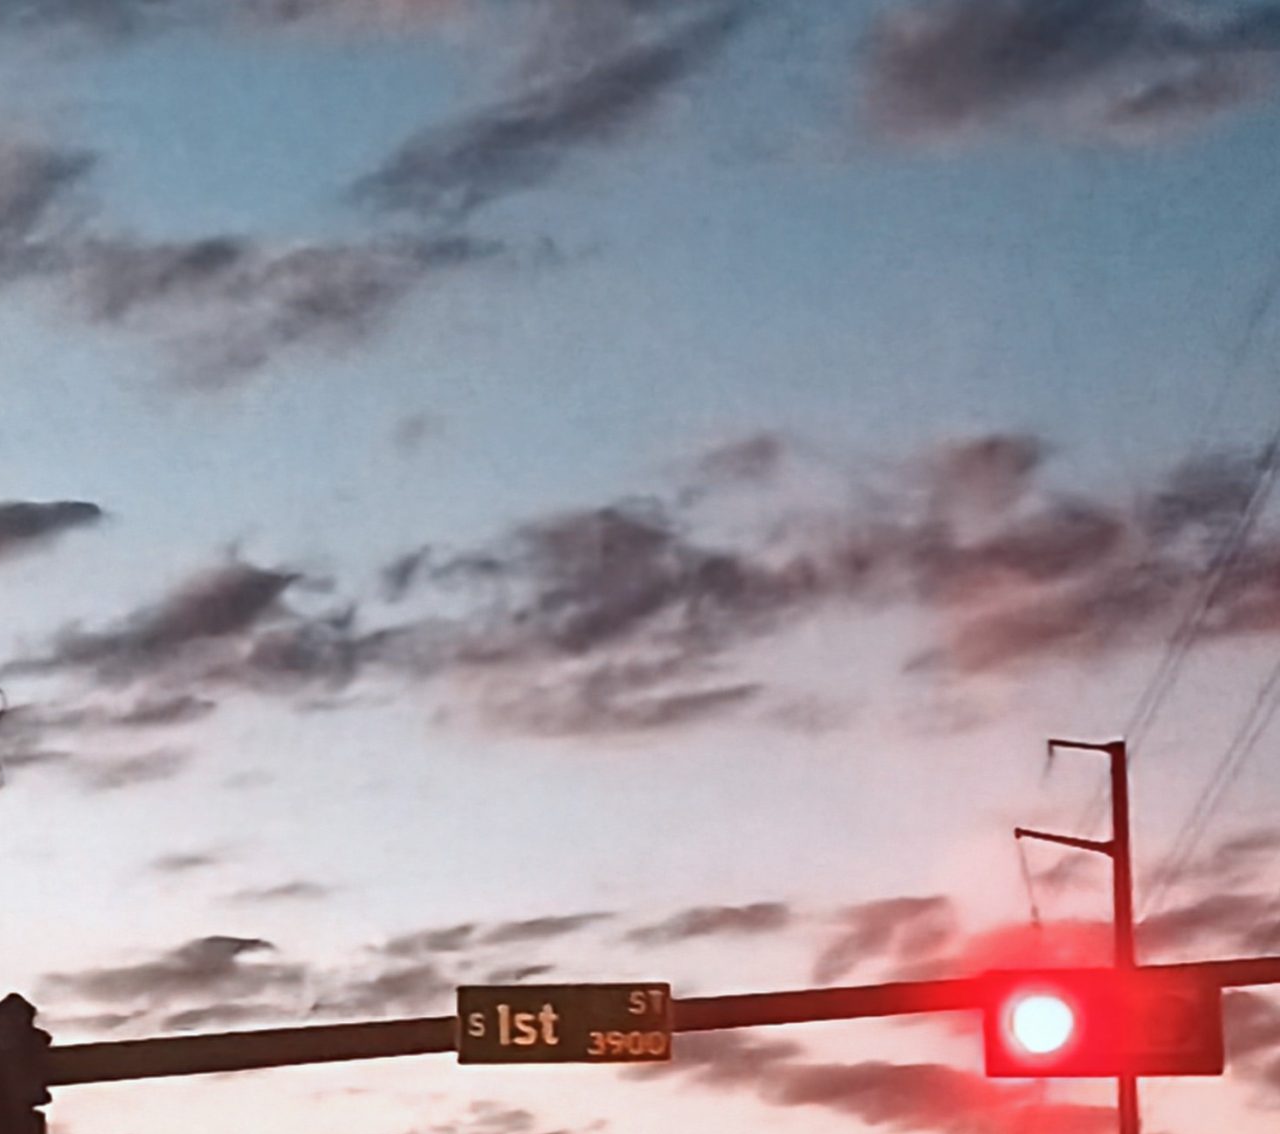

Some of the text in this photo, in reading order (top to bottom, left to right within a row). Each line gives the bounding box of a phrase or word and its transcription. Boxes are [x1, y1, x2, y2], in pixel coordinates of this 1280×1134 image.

[628, 990, 665, 1014] ST
[468, 1003, 559, 1046] S 1st
[587, 1031, 667, 1055] 3900
